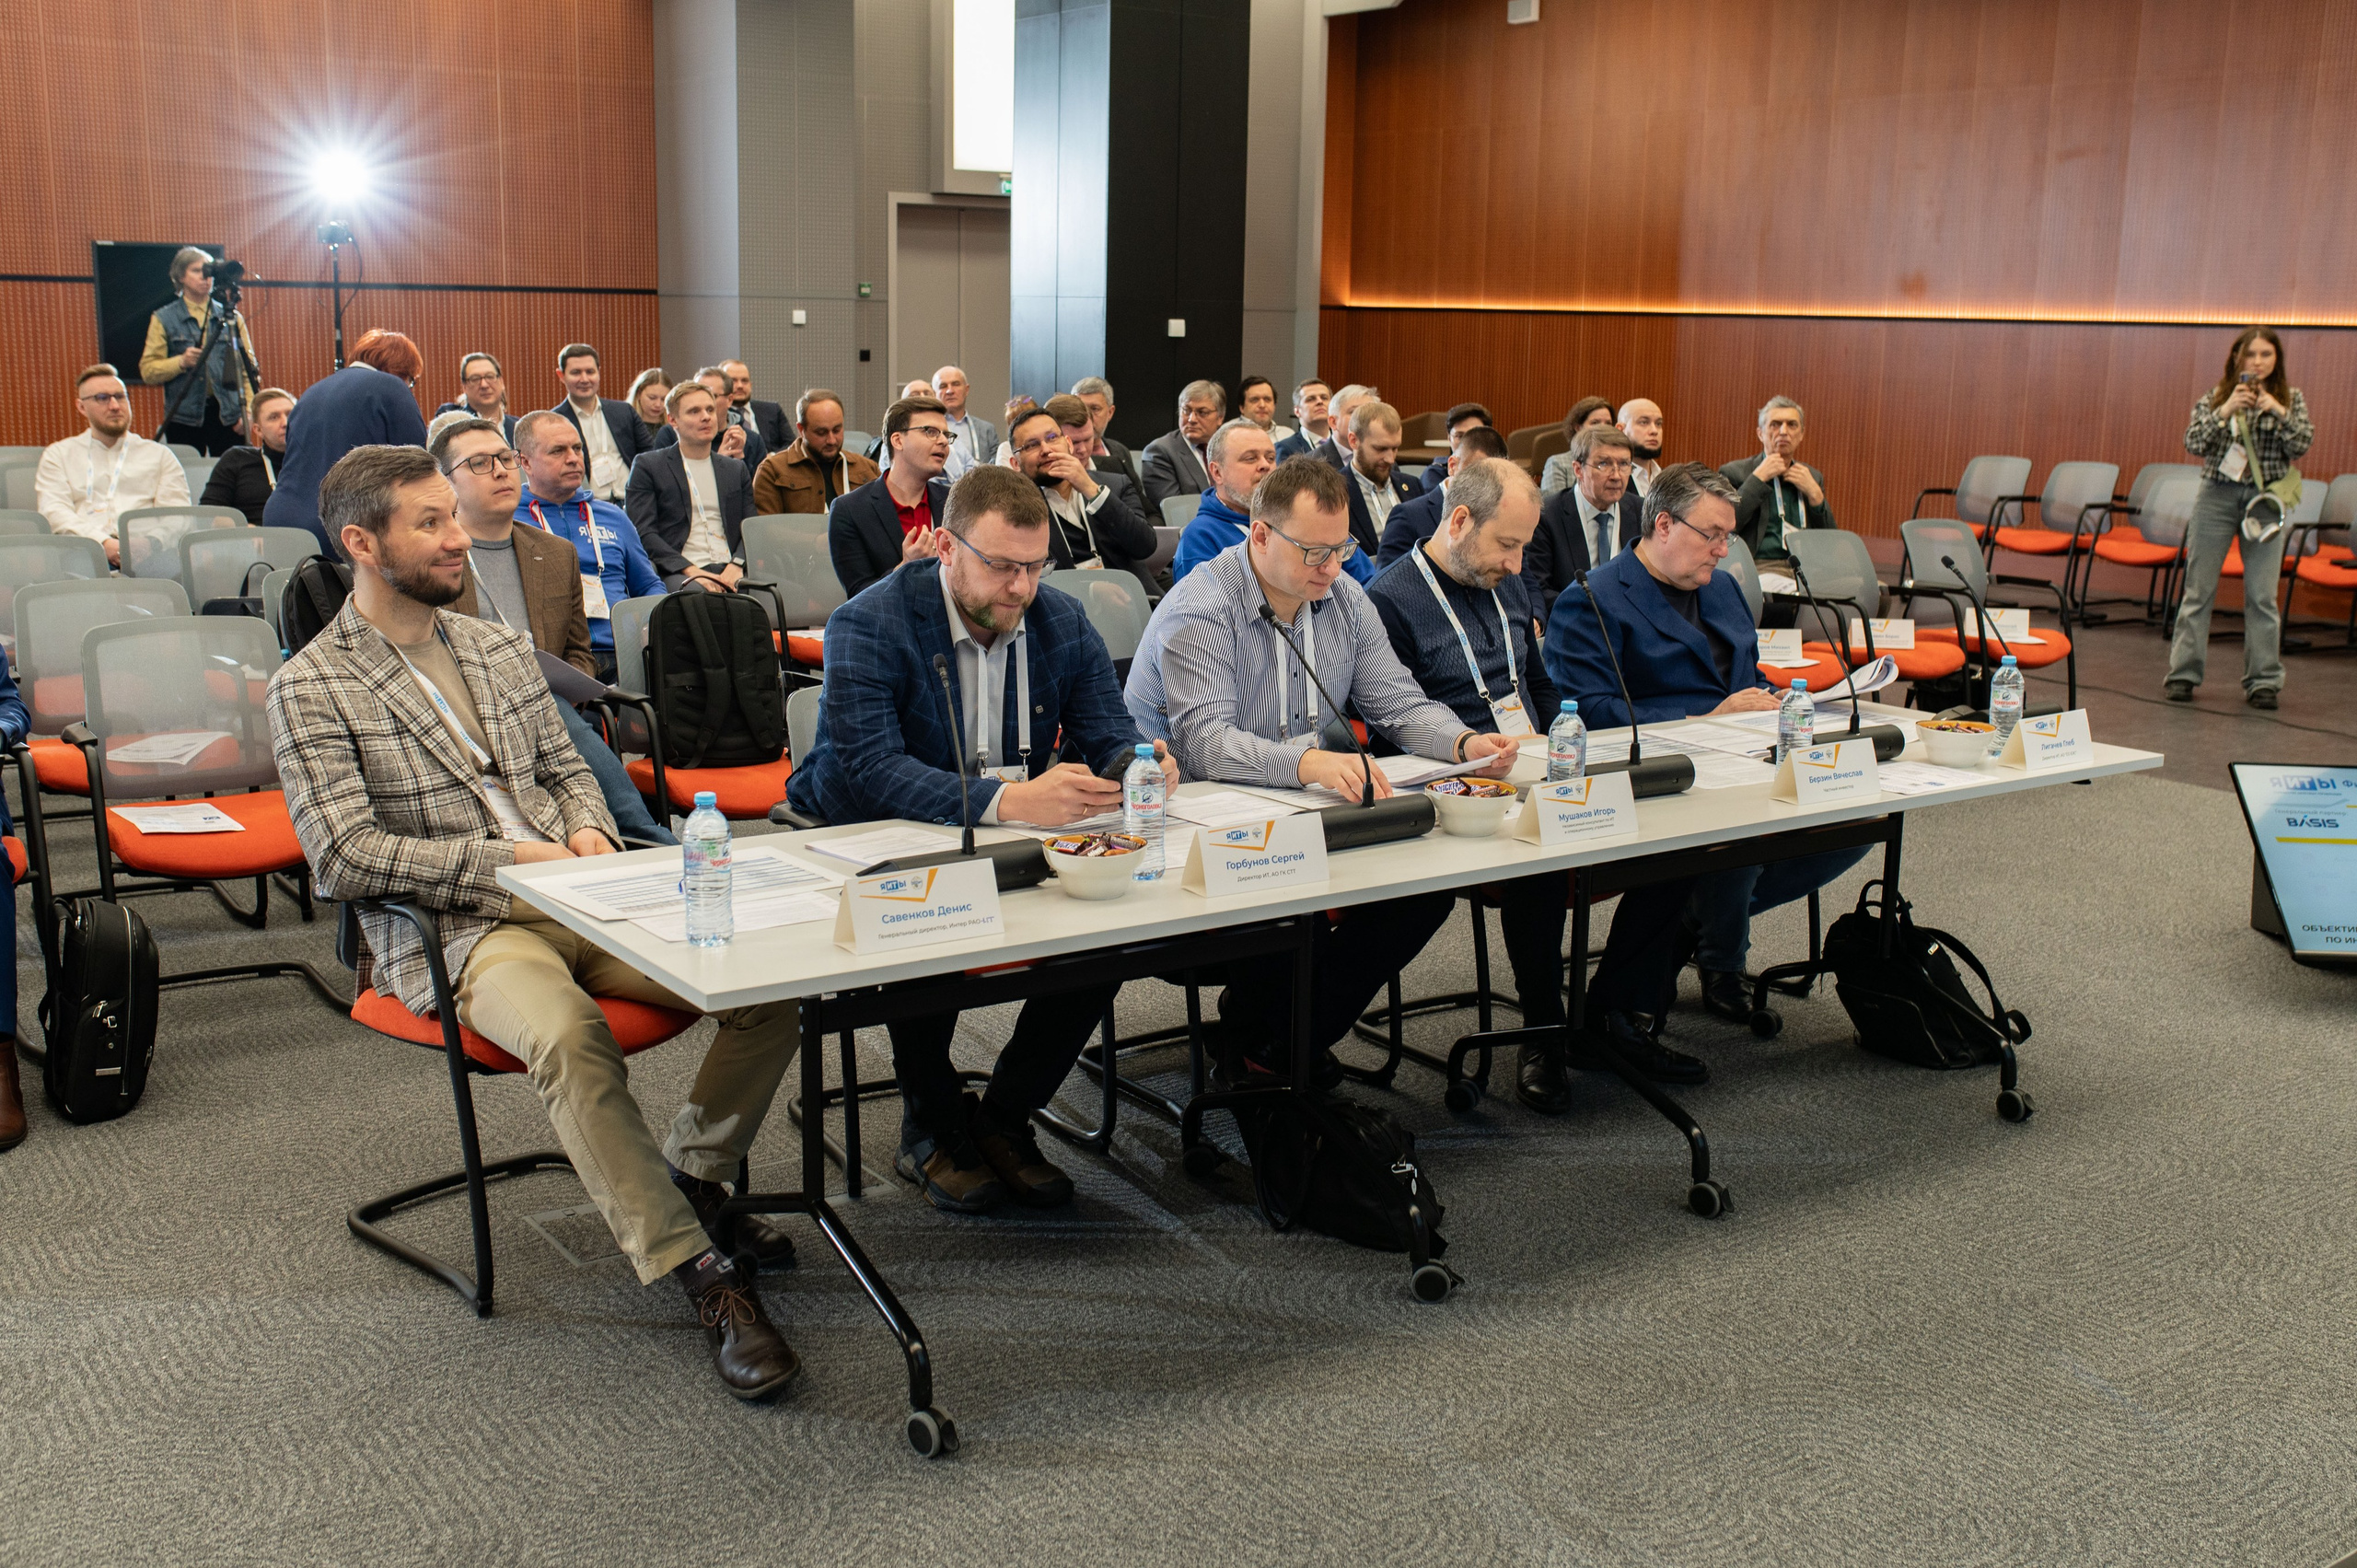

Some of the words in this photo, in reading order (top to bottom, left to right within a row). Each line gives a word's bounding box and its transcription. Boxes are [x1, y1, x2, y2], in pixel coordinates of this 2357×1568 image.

[578, 524, 618, 540] ЯТЫ
[2062, 738, 2075, 747] Глеб
[1809, 774, 1832, 784] Берзин
[1833, 770, 1864, 780] Вячеслав
[2270, 775, 2337, 791] ЯИТЫ
[1558, 810, 1593, 823] Мушаков
[1594, 807, 1616, 818] Игорь
[2286, 815, 2340, 828] BASIS
[1226, 857, 1270, 871] Горбунов
[1271, 852, 1305, 865] Сергей
[879, 879, 907, 891] ЯИТЫ
[1237, 874, 1262, 883] Директор
[881, 909, 935, 924] Савенков
[937, 902, 972, 918] Денис
[878, 927, 918, 940] Генеральный
[948, 922, 968, 931] Интер
[2302, 924, 2357, 933] ОБЪЕКТИ
